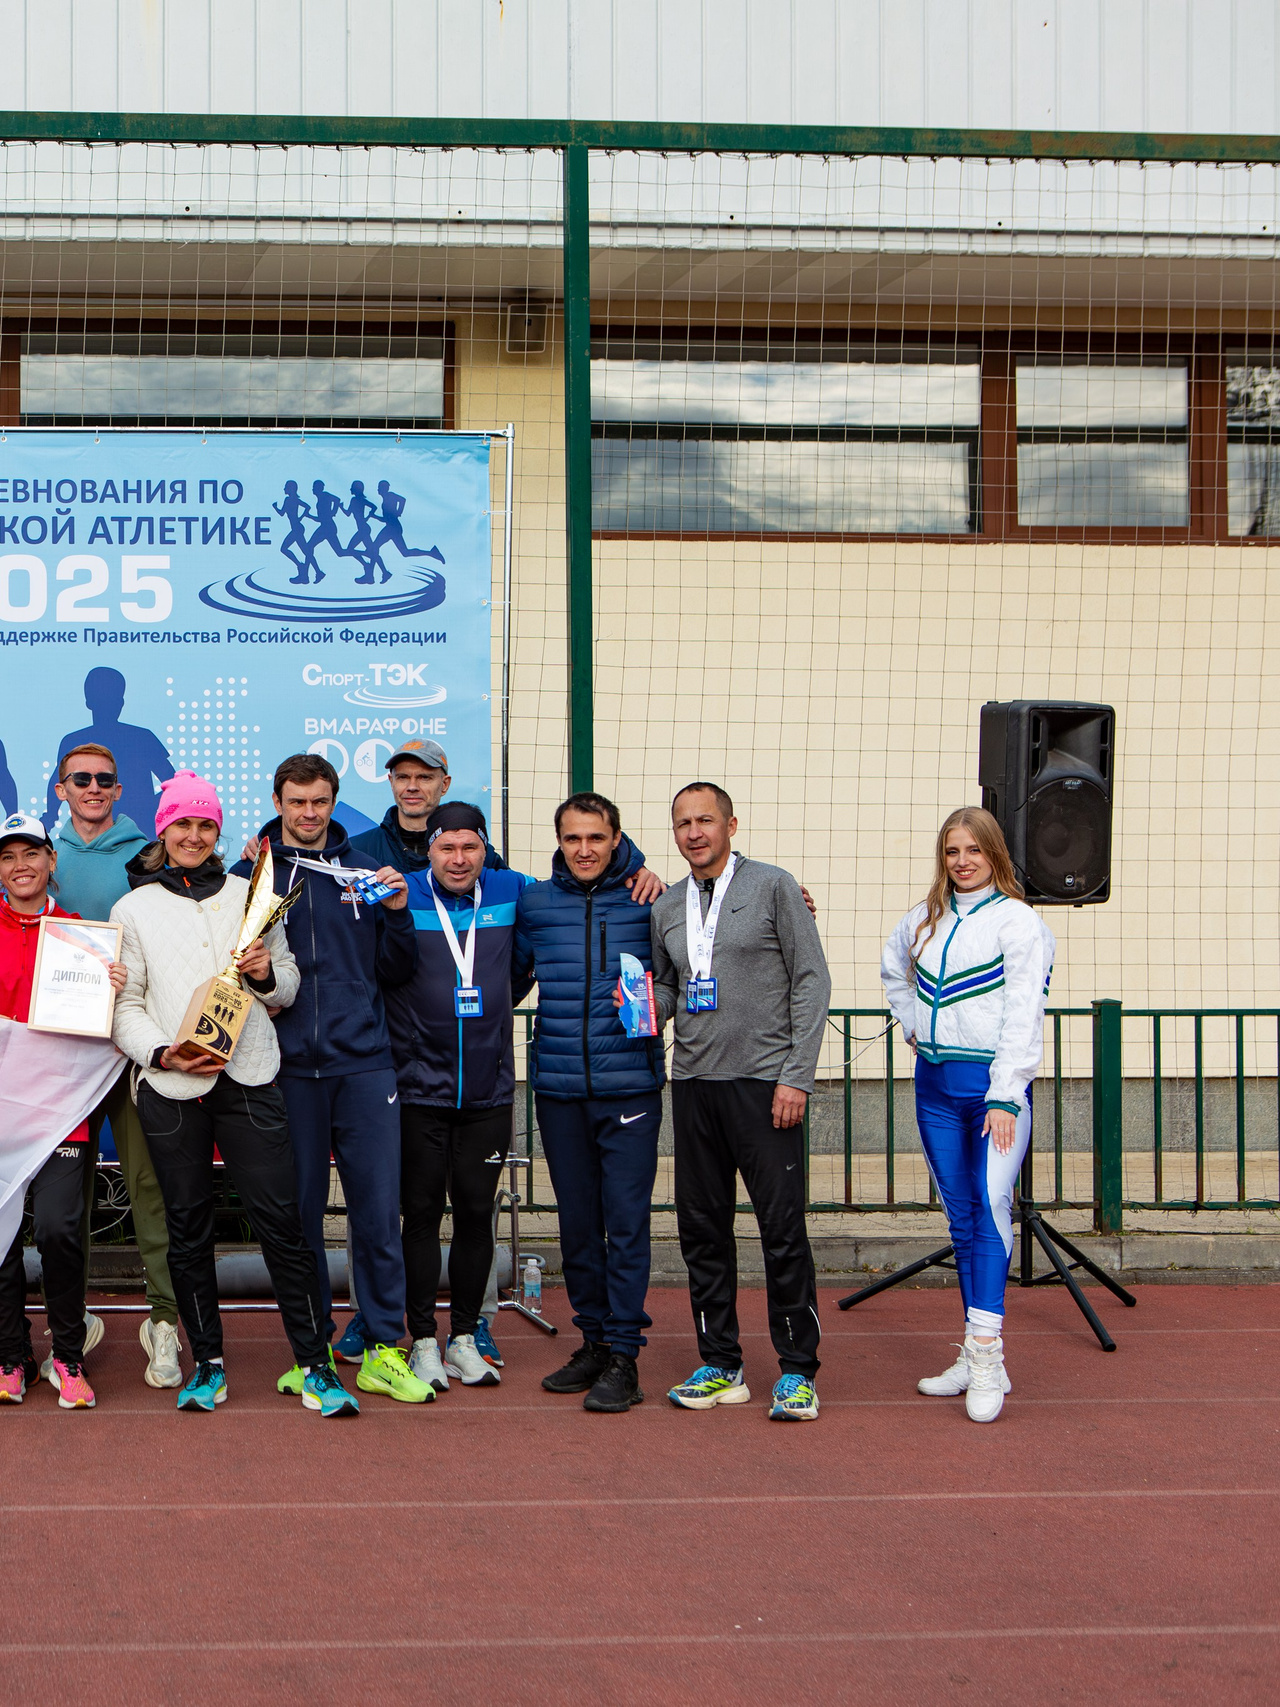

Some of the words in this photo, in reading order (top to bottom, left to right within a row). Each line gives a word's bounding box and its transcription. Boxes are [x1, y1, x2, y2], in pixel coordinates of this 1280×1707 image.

[199, 479, 244, 505] ПО
[88, 516, 273, 546] АТЛЕТИКЕ
[84, 628, 221, 646] Правительства
[228, 628, 334, 645] Российской
[339, 628, 447, 647] Федерации
[304, 717, 447, 735] ВМАРАФОНЕ
[51, 969, 102, 985] ДИПЛОМ
[201, 1020, 207, 1029] 3
